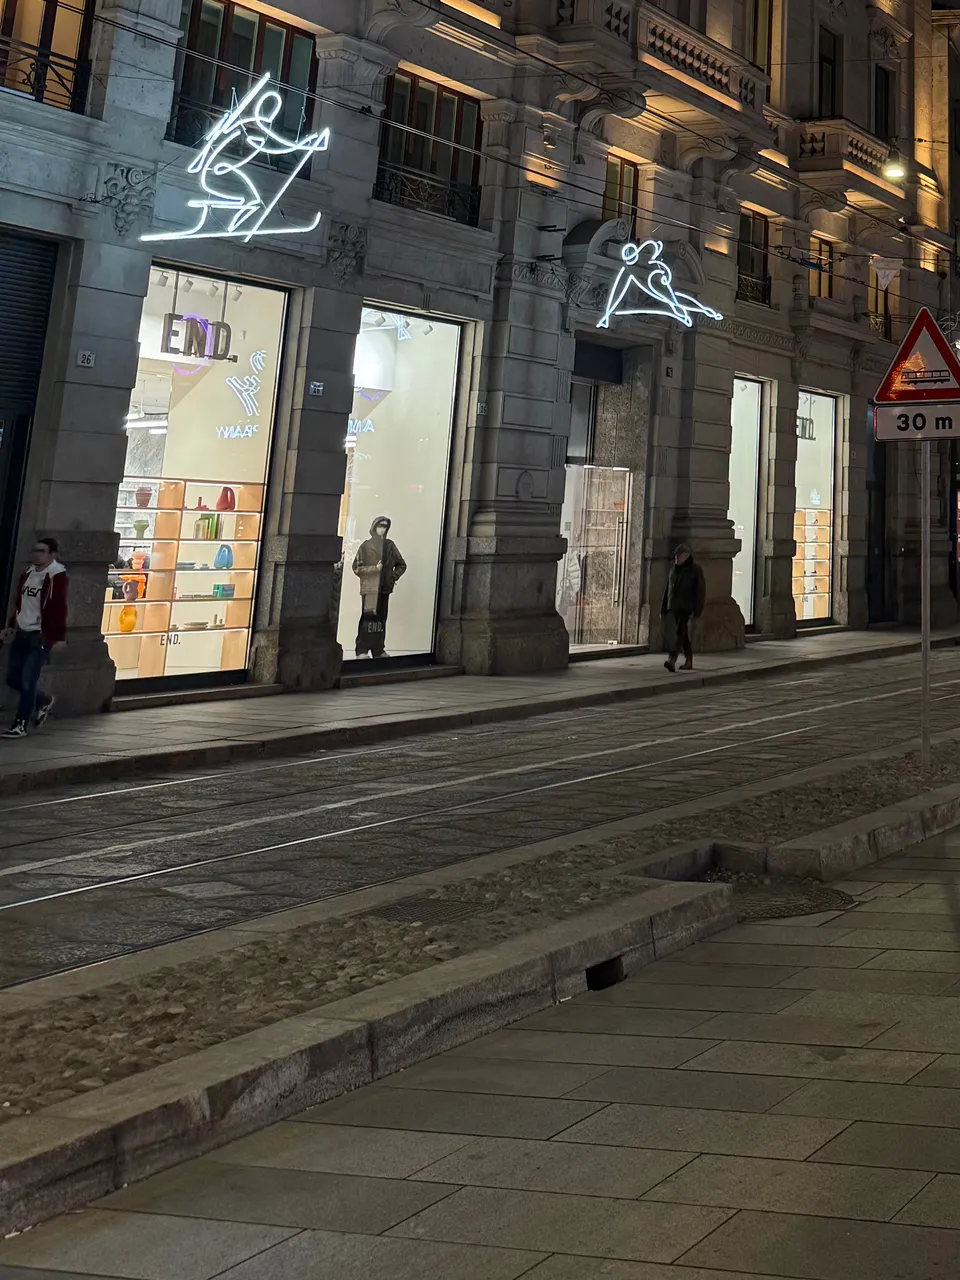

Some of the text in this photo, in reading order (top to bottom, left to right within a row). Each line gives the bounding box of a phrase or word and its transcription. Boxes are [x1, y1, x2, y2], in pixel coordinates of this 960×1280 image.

[160, 313, 238, 363] END.
[81, 353, 92, 365] 26
[896, 412, 953, 432] 30 m
[367, 621, 384, 633] END.
[160, 634, 181, 646] END.
